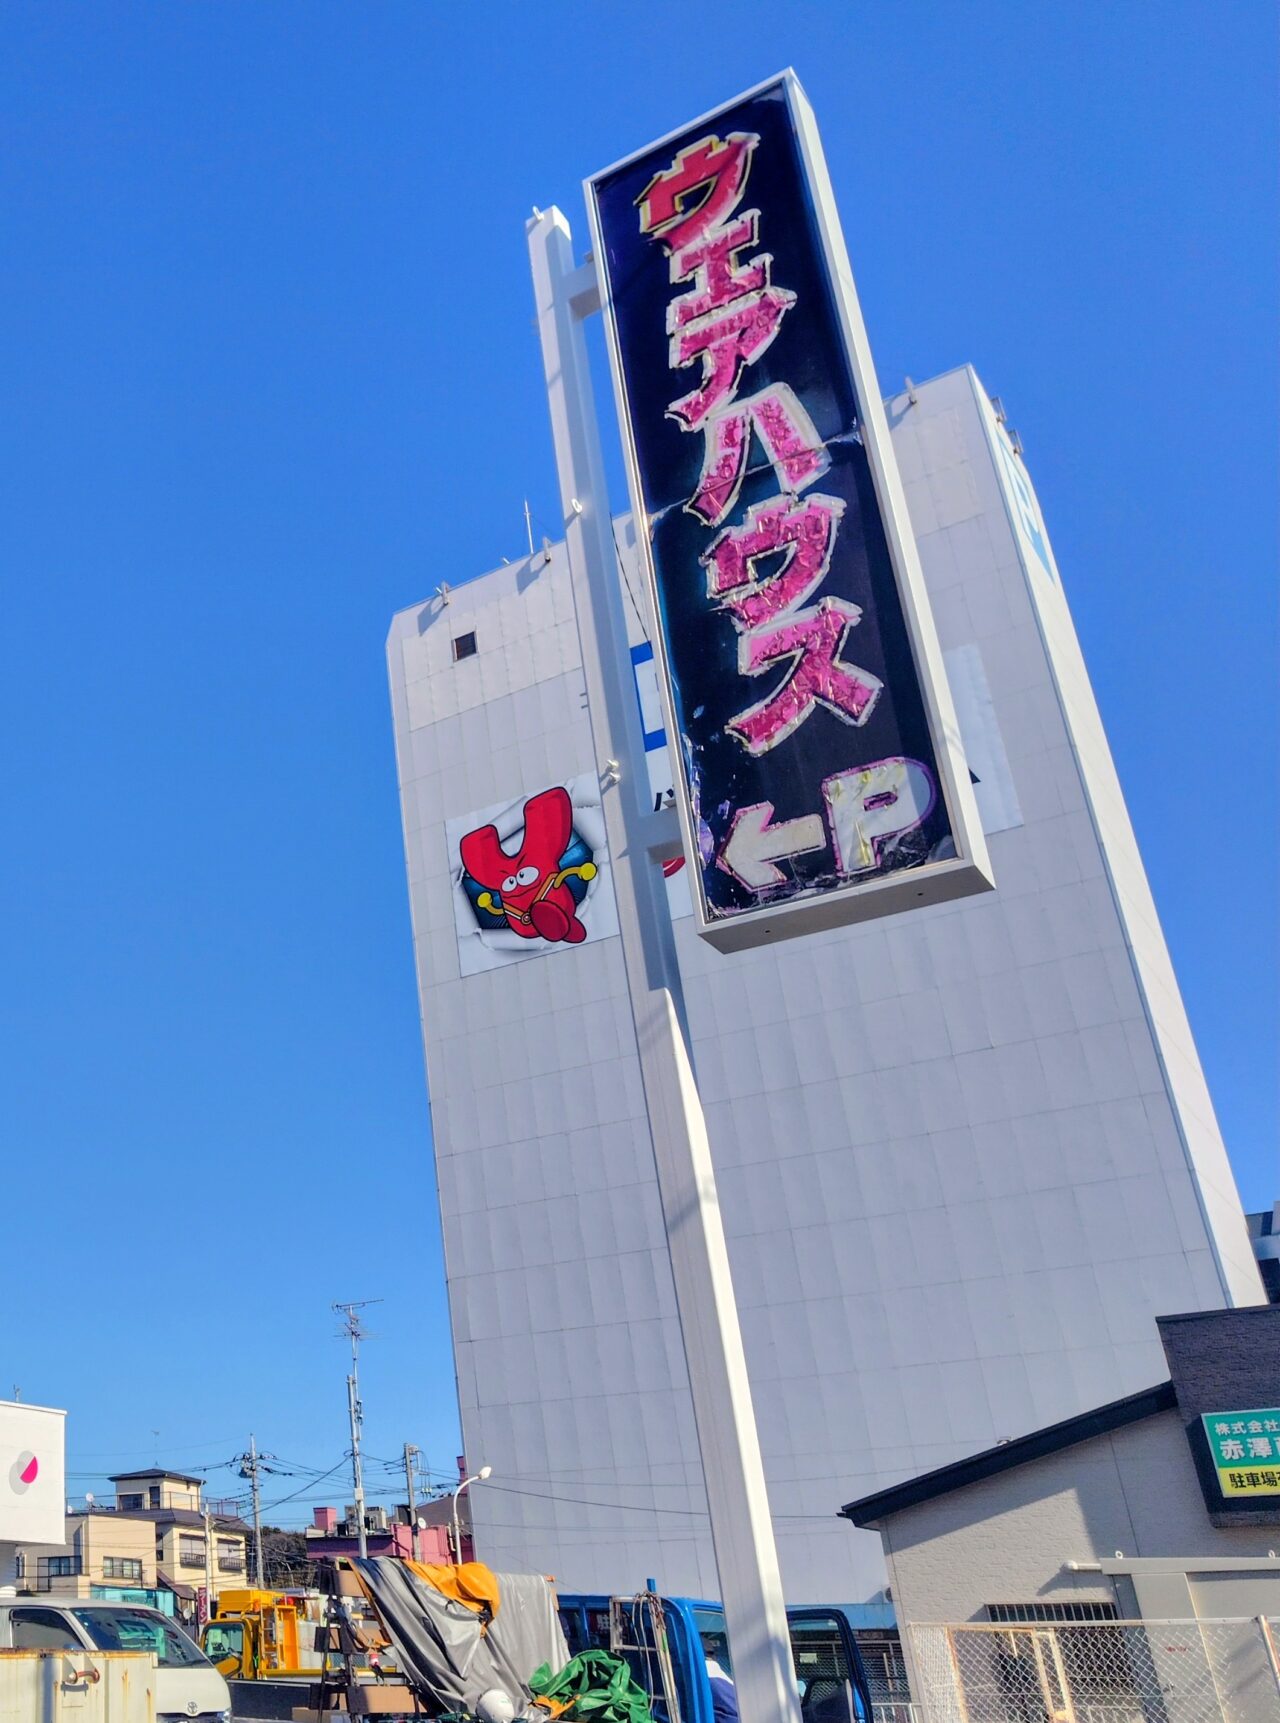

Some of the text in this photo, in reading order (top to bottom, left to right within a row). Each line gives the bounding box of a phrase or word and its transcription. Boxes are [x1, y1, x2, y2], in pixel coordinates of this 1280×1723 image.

[633, 132, 884, 757] ウエアハウス
[821, 756, 938, 877] P
